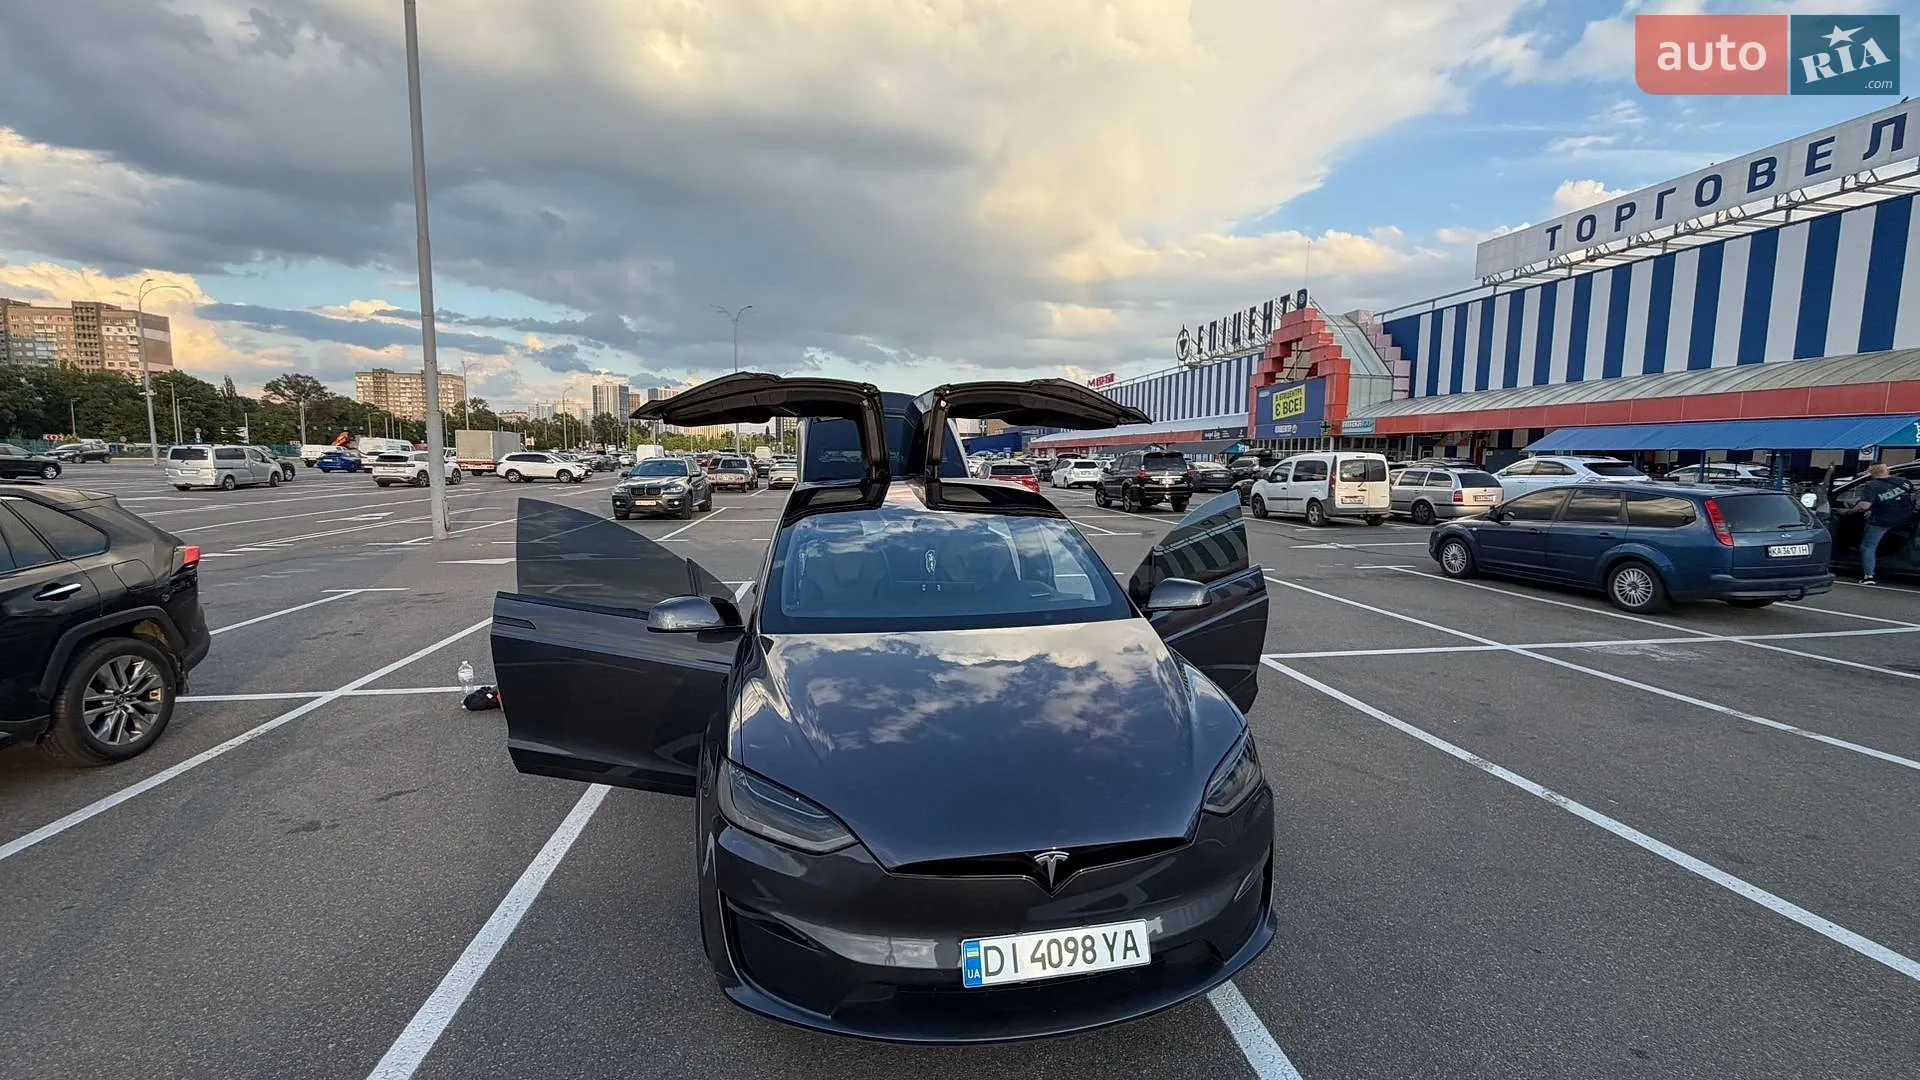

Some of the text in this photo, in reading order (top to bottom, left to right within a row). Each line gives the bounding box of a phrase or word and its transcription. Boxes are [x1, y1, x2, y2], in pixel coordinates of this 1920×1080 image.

[983, 929, 1141, 977] DI 4098 YA
[967, 968, 981, 980] UA
